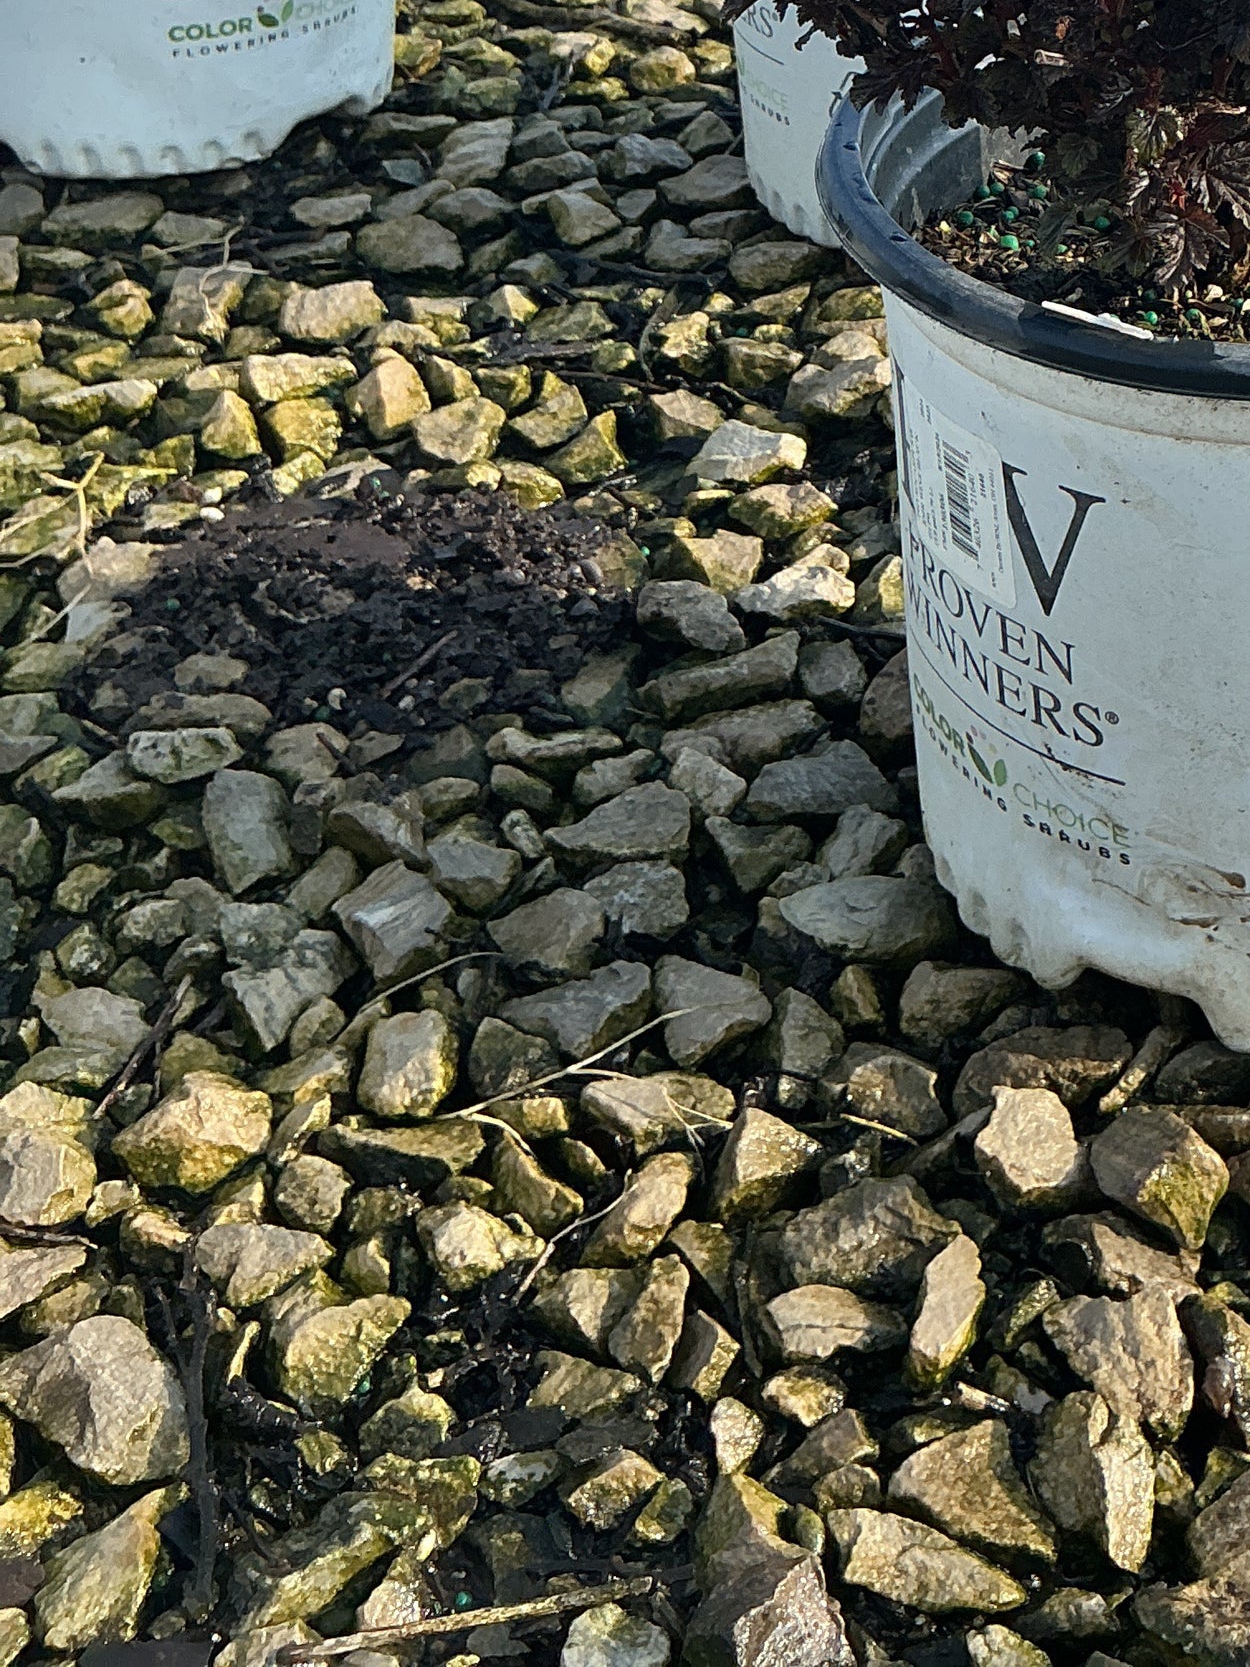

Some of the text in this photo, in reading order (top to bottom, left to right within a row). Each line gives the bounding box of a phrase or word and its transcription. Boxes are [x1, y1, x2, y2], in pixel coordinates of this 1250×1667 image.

[167, 16, 253, 43] COLOR
[172, 29, 291, 59] FLOWERING
[907, 526, 1076, 685] PROVEN
[913, 673, 1132, 850] COLOR CHOICE
